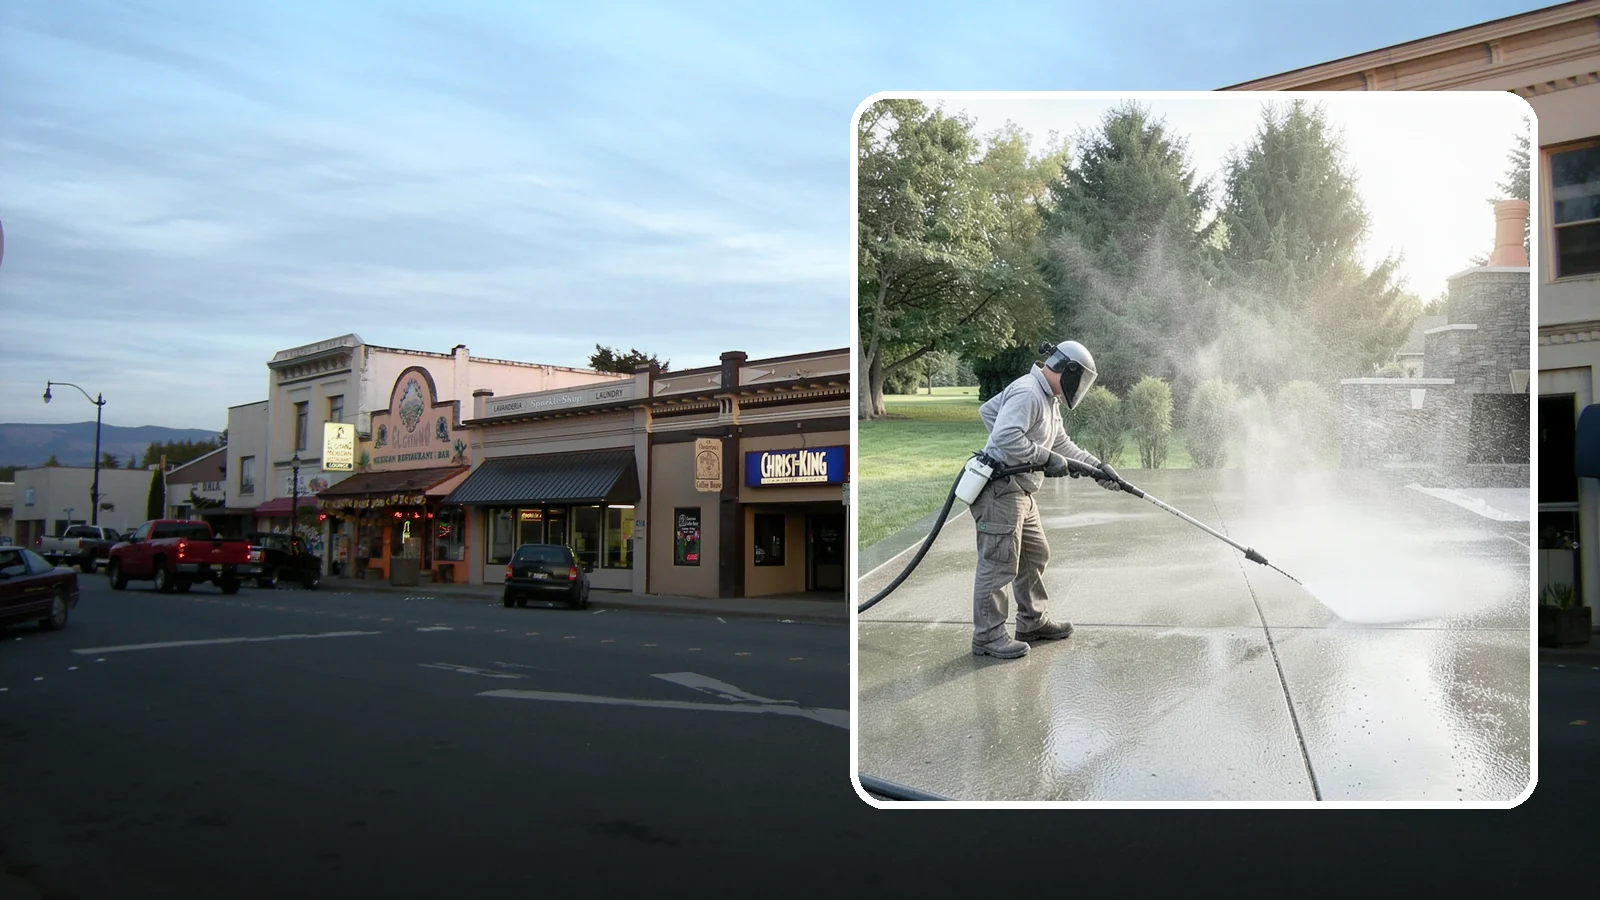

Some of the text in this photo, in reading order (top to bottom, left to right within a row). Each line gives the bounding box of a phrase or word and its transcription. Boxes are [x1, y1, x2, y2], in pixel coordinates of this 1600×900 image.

[595, 389, 624, 400] LAUNDRY
[493, 402, 523, 413] LAVANDERIA
[530, 395, 582, 409] Sparkle Shop
[373, 450, 450, 465] MEXICAN RESTAURANT BAR
